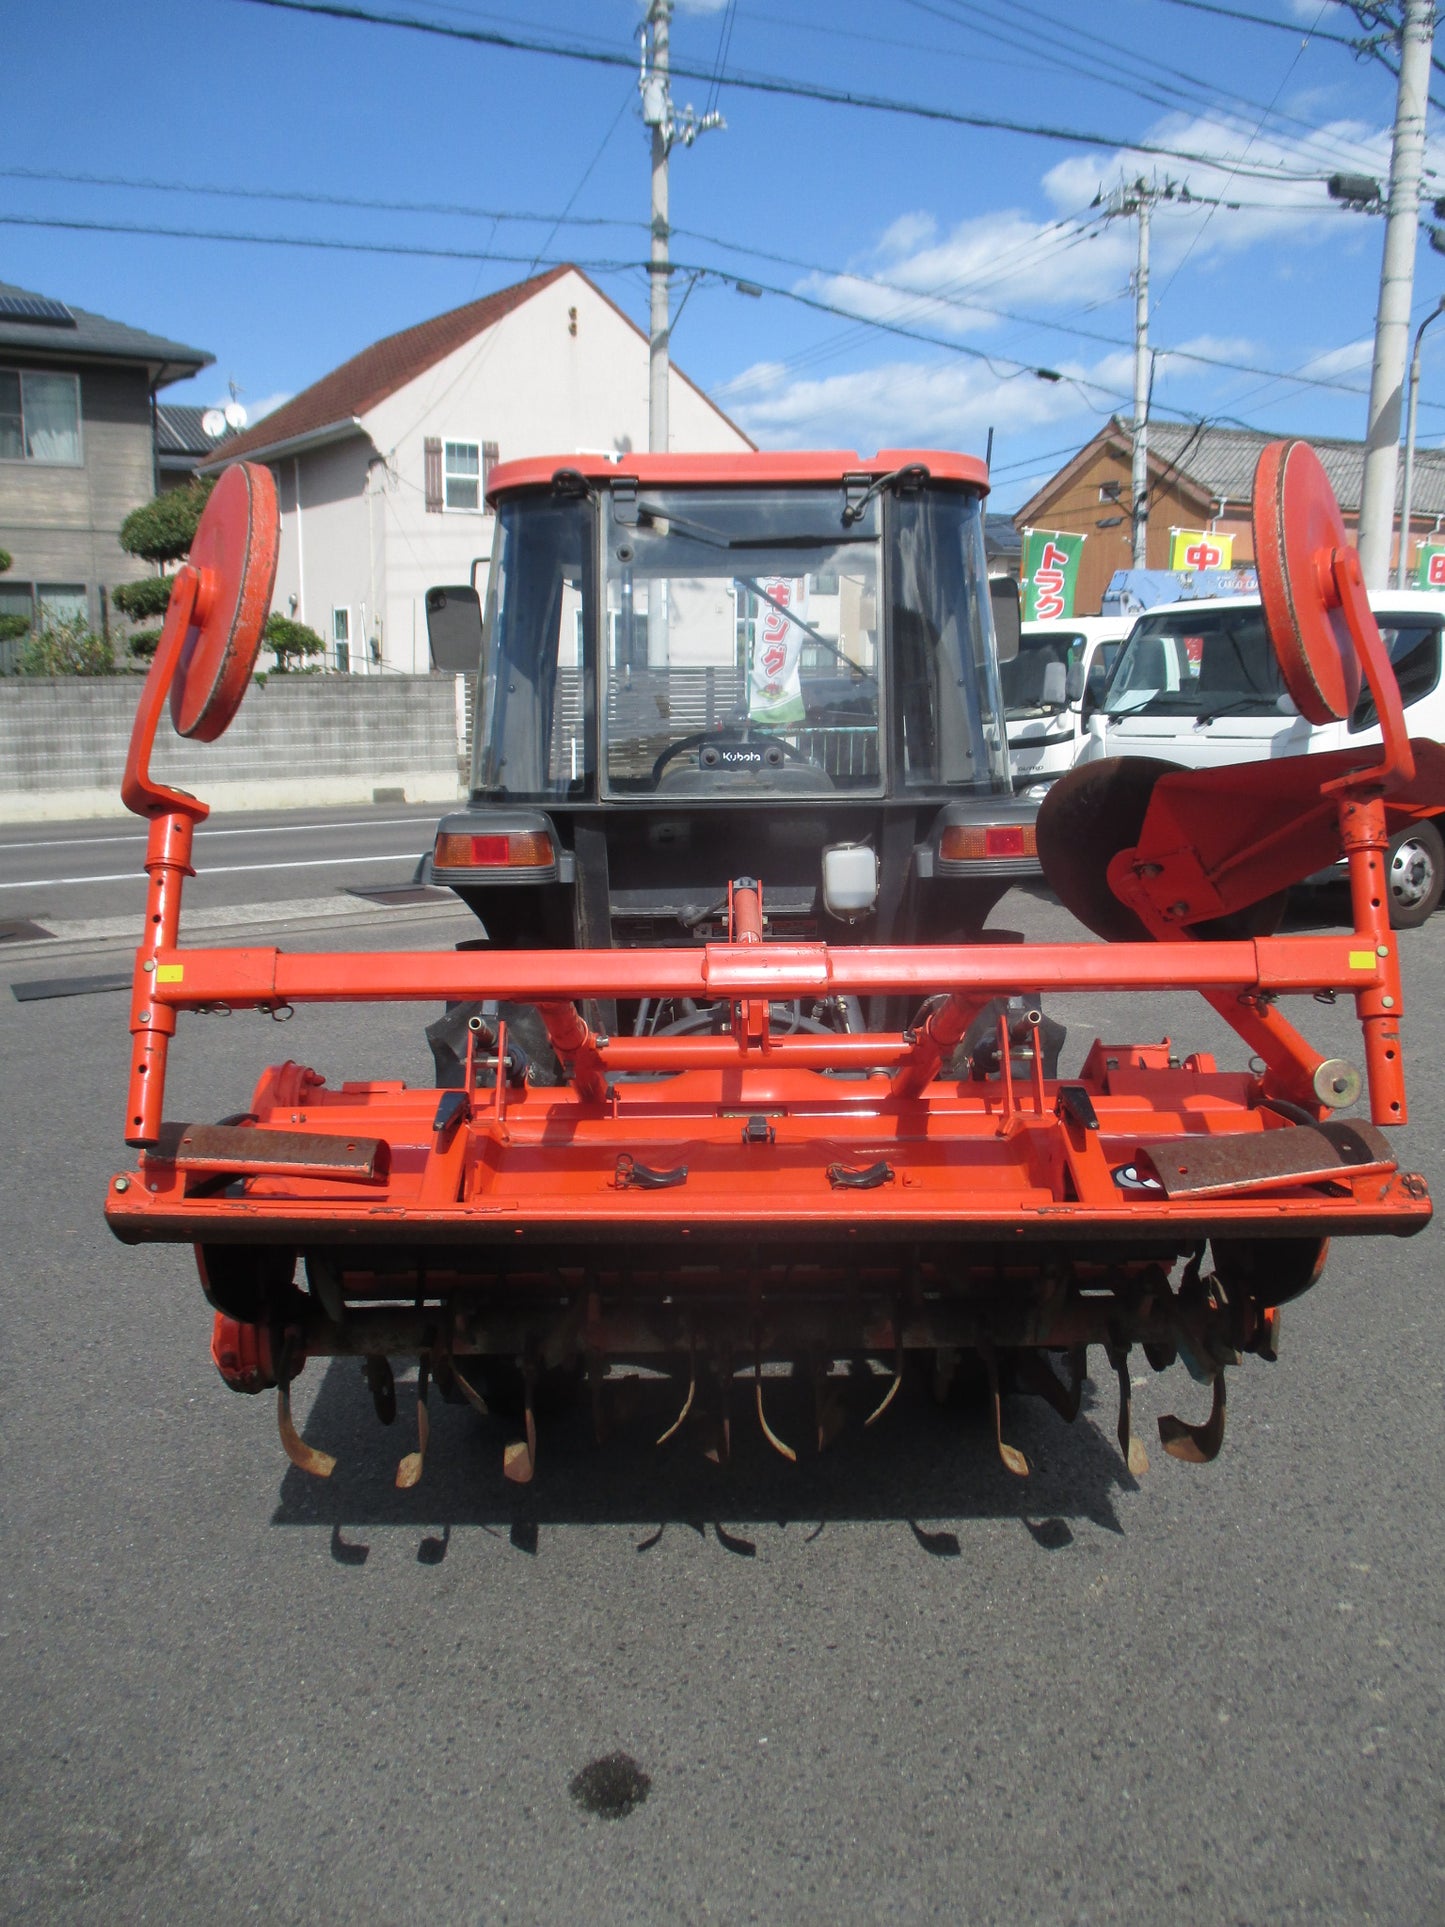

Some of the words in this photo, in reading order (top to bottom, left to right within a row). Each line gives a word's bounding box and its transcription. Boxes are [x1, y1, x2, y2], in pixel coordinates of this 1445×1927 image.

[1185, 541, 1221, 571] 中
[762, 577, 790, 677] キング
[723, 752, 761, 762] Kubota
